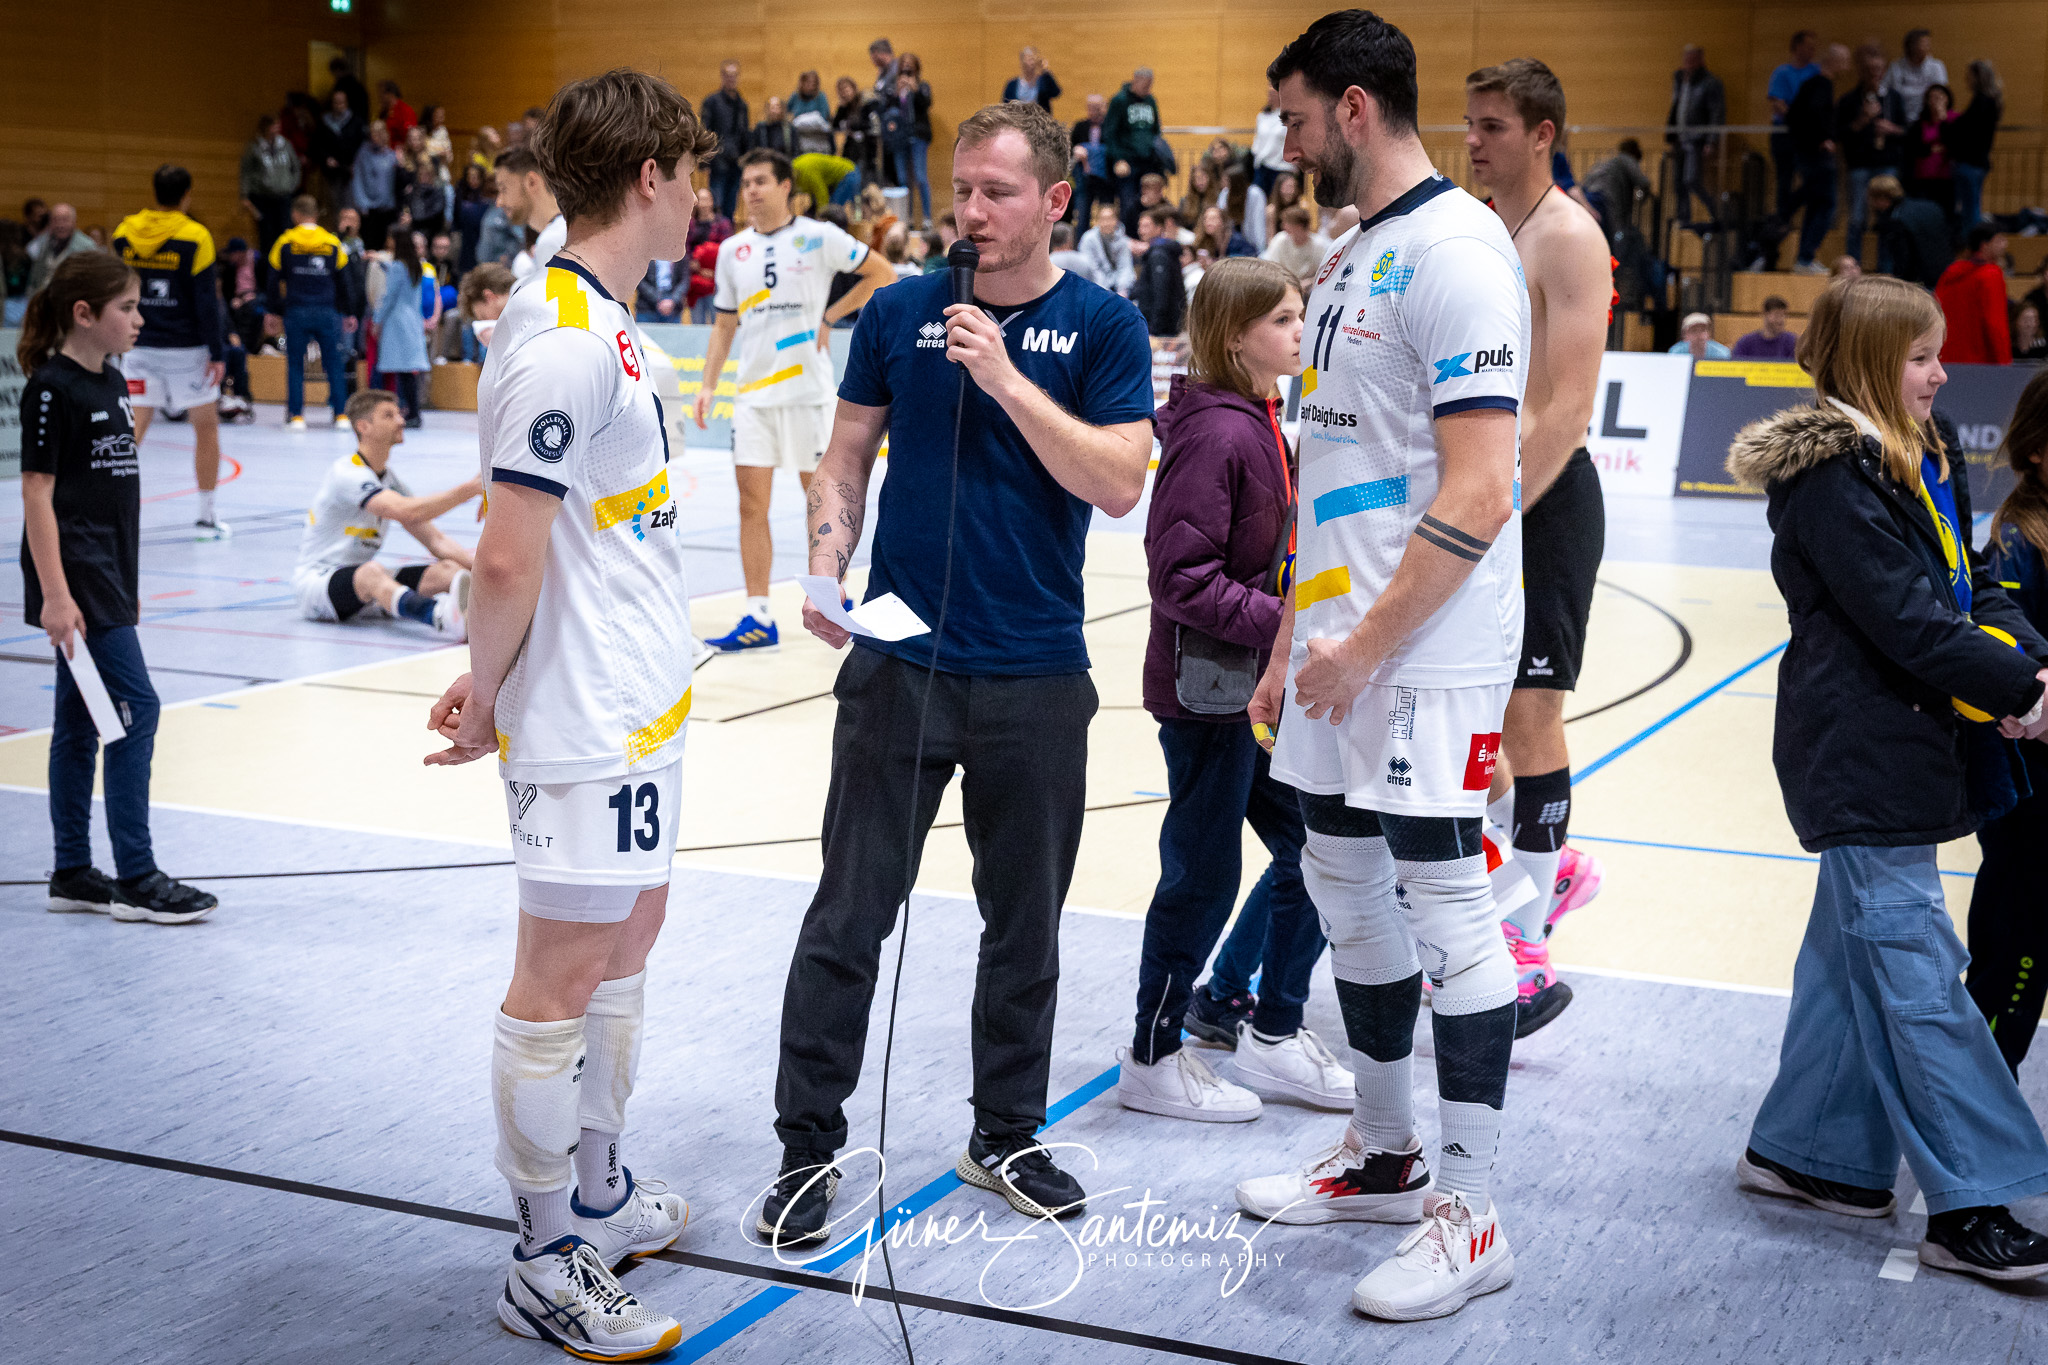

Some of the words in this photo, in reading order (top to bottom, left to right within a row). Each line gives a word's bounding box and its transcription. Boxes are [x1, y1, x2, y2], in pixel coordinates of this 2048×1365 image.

[764, 262, 777, 289] 5
[916, 338, 946, 348] errea
[1022, 326, 1079, 355] MW
[1312, 304, 1345, 372] 11
[1342, 323, 1381, 341] Heinzelmann
[1474, 343, 1514, 374] puls
[1301, 403, 1311, 424] apf
[1311, 404, 1358, 429] Daigfuss
[1587, 381, 1648, 439] L
[536, 416, 570, 436] VOLLEYBALL
[1957, 422, 2004, 450] ND
[1592, 447, 1643, 473] nik
[1388, 685, 1411, 740] HÜTT
[1386, 773, 1412, 787] errea
[608, 781, 660, 853] 13
[609, 1142, 617, 1173] CRAFT
[517, 1196, 533, 1231] CRAFT
